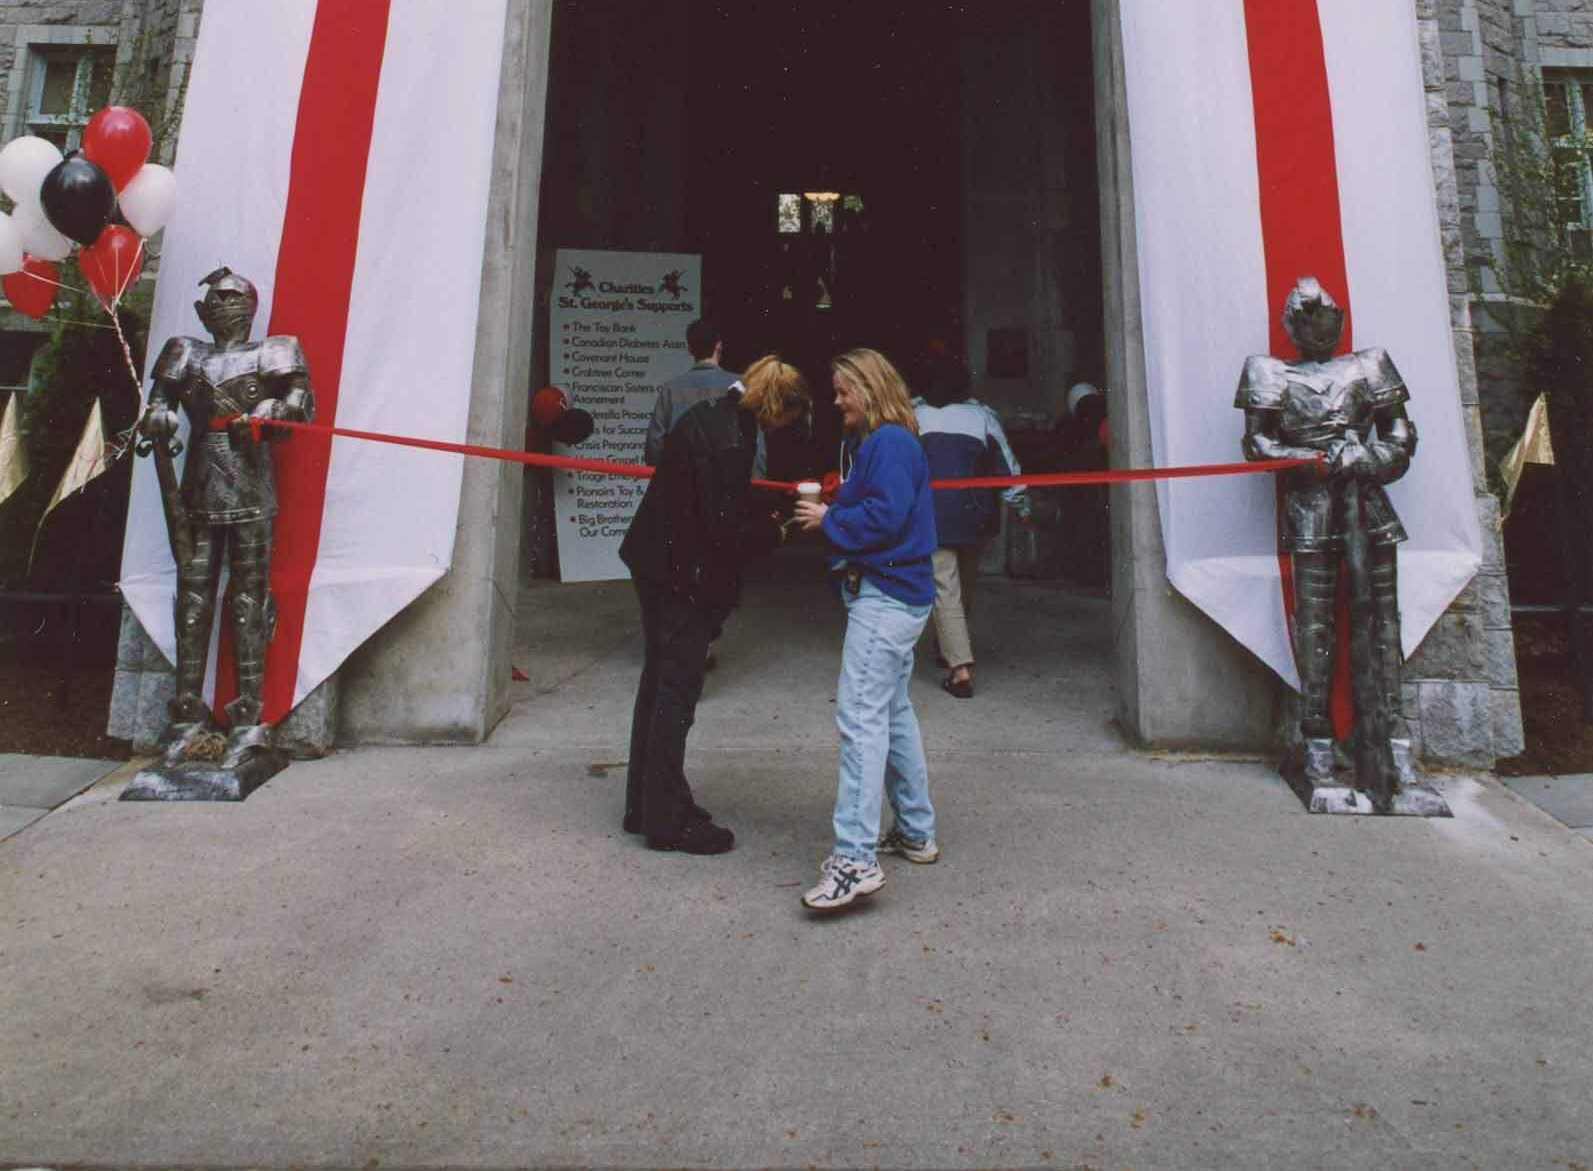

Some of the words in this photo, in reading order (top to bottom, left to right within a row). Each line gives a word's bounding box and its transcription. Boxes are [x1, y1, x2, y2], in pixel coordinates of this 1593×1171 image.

[598, 281, 655, 294] Charities
[558, 297, 578, 309] St.
[580, 297, 634, 312] George's
[637, 299, 694, 313] Supports
[572, 321, 590, 332] The
[594, 321, 610, 334] Toy
[571, 336, 617, 348] Canadian
[619, 337, 660, 349] Diabetes
[571, 351, 617, 363] Covenant
[619, 352, 649, 363] House
[571, 365, 612, 377] Crabtree
[614, 366, 646, 377] Corner
[572, 381, 623, 393] Franciscan
[625, 382, 654, 392] Sisters
[573, 394, 625, 404] Atonement
[616, 485, 633, 498] Toy
[577, 498, 633, 508] Restoration
[578, 514, 595, 526] Big
[580, 526, 598, 537] Our
